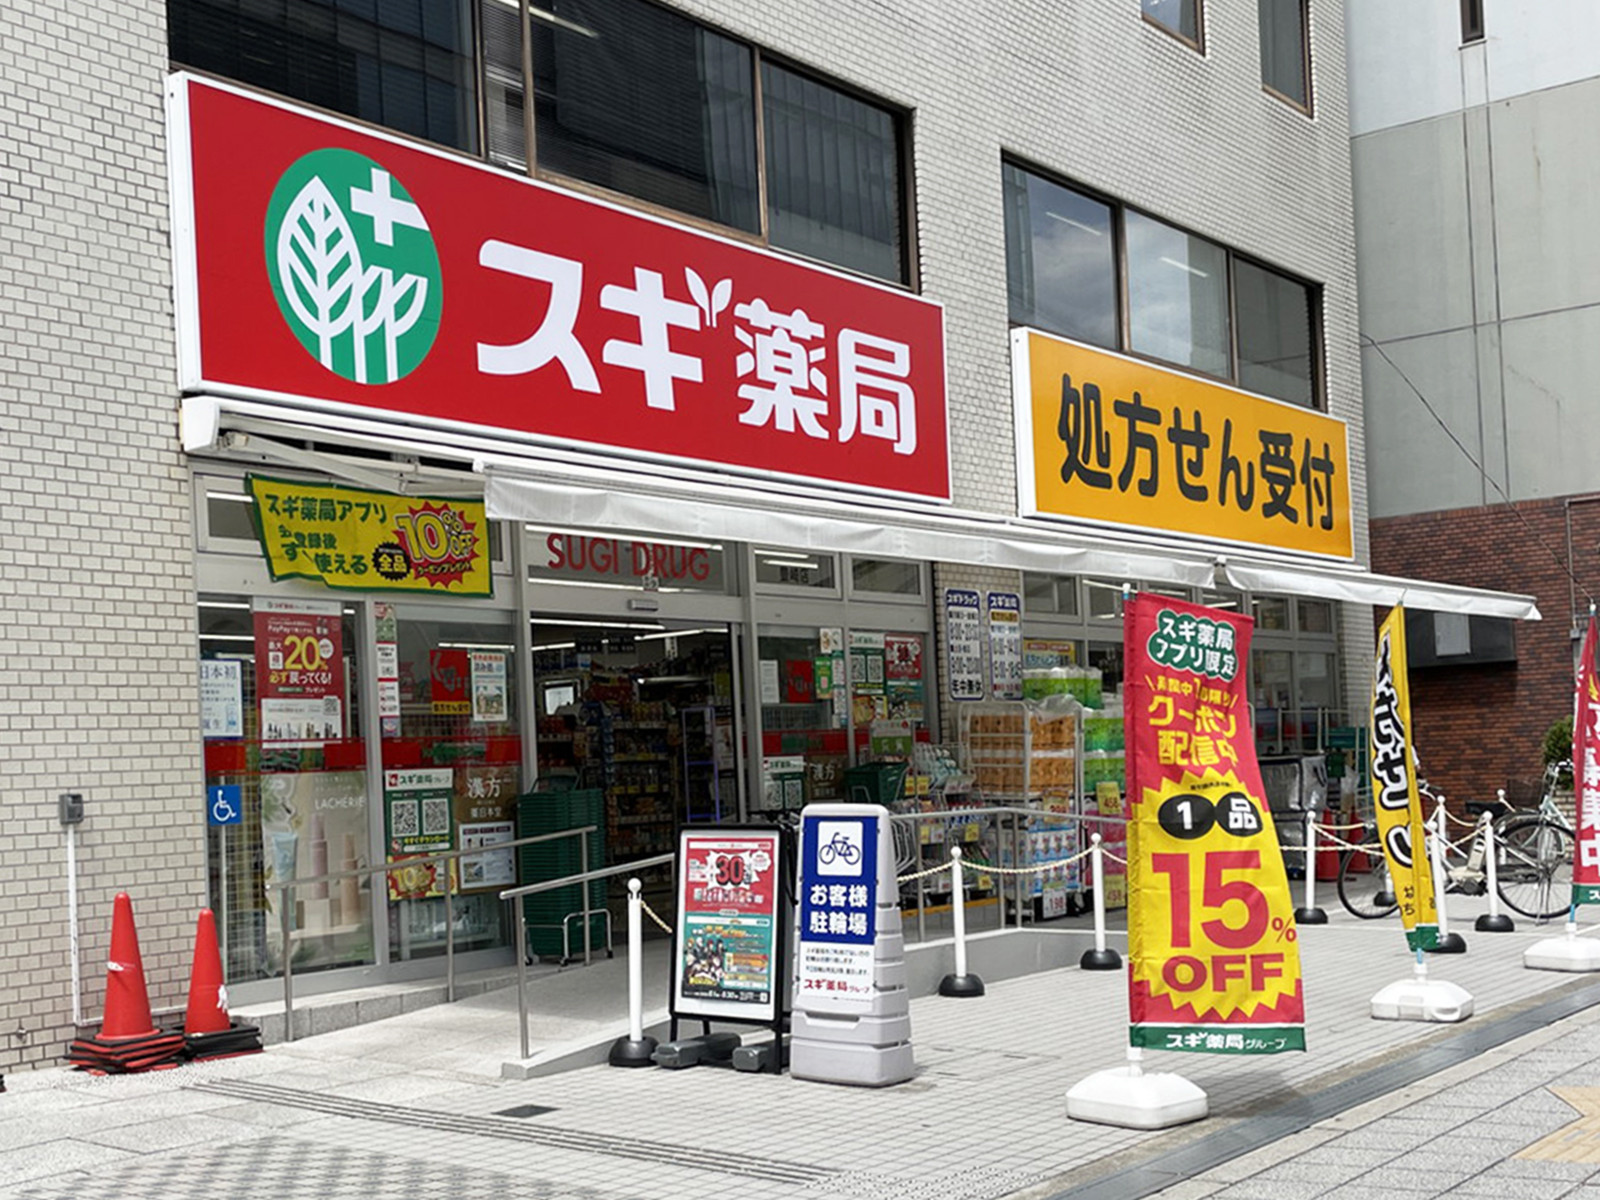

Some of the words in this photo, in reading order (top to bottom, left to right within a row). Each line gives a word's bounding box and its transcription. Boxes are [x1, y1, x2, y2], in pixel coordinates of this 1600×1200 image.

[477, 239, 917, 455] スギ薬局
[1057, 373, 1335, 531] 処方せん受付
[264, 494, 388, 524] スギ薬局アプリ
[378, 555, 409, 573] 全品
[546, 532, 618, 574] SUGI
[629, 541, 711, 581] DRUG
[1162, 617, 1234, 651] スギ薬局
[1155, 637, 1236, 677] アプリ限定
[1147, 695, 1237, 739] クーポン
[1157, 730, 1240, 768] 配信中
[466, 776, 502, 798] 漢方
[715, 855, 745, 887] 30
[809, 884, 868, 908] お客様
[1151, 849, 1297, 950] 15%
[809, 911, 868, 936] 駐輪場
[803, 979, 870, 993] スギ薬局グループ
[1162, 953, 1285, 993] OFF
[1165, 1031, 1288, 1051] スギ薬局グループ
